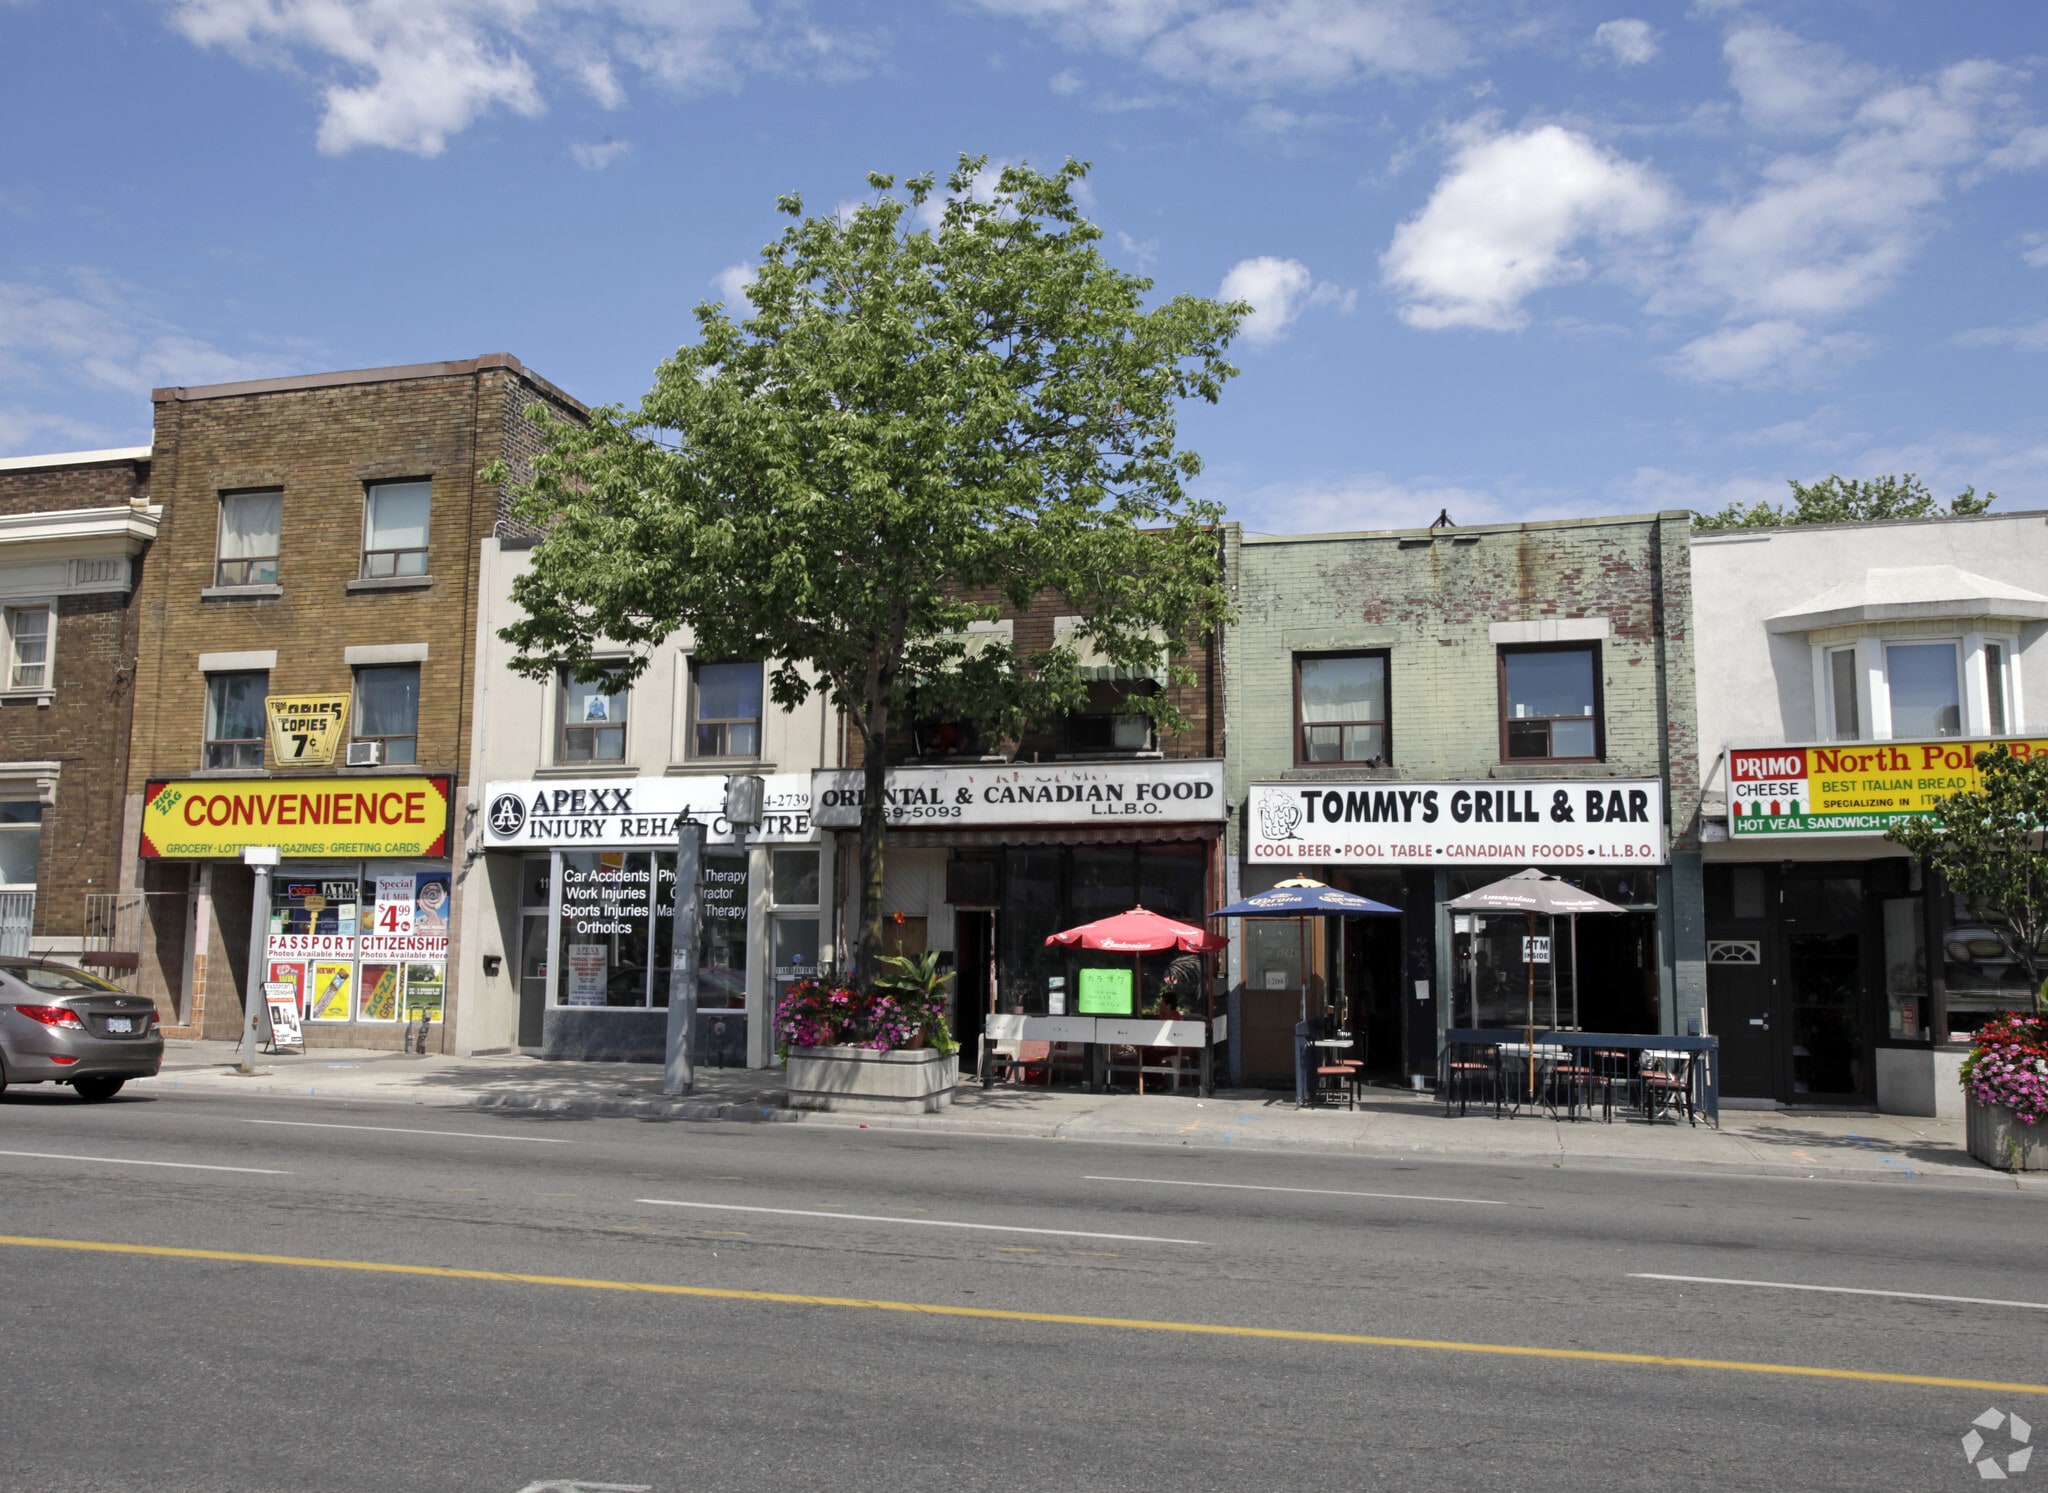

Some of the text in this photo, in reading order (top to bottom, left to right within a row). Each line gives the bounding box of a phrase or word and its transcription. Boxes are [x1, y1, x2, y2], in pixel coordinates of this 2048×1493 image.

[282, 718, 327, 731] COPIES
[1813, 746, 1911, 773] North
[1920, 745, 1986, 770] Pol
[1735, 756, 1801, 779] PRIMO
[1736, 783, 1800, 796] CHEESE
[1822, 780, 1858, 792] BEST
[1862, 778, 1913, 791] ITALIAN
[1918, 777, 1967, 789] BREAD
[530, 788, 633, 814] APEXX
[822, 782, 1214, 807] ORINTAL & CANADIAN FOOD
[160, 791, 183, 816] ZAG
[184, 792, 426, 826] CONVENIENCE
[1091, 803, 1162, 815] L.L.B.O.
[1301, 789, 1650, 823] TOMMY'S GRILL & BAR
[1823, 799, 1894, 808] SPECIALIZING
[1899, 798, 1910, 806] IN
[530, 819, 606, 838] INJURY
[713, 815, 810, 834] CTRE
[1738, 819, 1765, 831] HOT
[1769, 818, 1805, 830] VEAL
[1807, 815, 1880, 829] SANDWICH
[166, 844, 213, 853] GROCERY
[330, 842, 381, 853] GREETING
[384, 842, 420, 853] CARDS
[1255, 844, 1656, 858] COOL BEER POOL TABLE CANADIAN FOODS L.L.B.O.
[564, 869, 650, 882] Car Accidents
[705, 869, 747, 884] Therapy
[289, 887, 317, 896] OPEN
[325, 883, 353, 898] ATM
[379, 879, 413, 891] Special
[566, 887, 646, 902] Work Injuries
[1479, 894, 1537, 904] Amsterdam
[562, 904, 600, 919] Sports
[604, 904, 649, 919] Injuries
[705, 904, 747, 919] Therapy
[577, 921, 632, 934] Orthotics
[269, 936, 355, 950] PASSPORT
[361, 937, 449, 950] CITIZENSHIP
